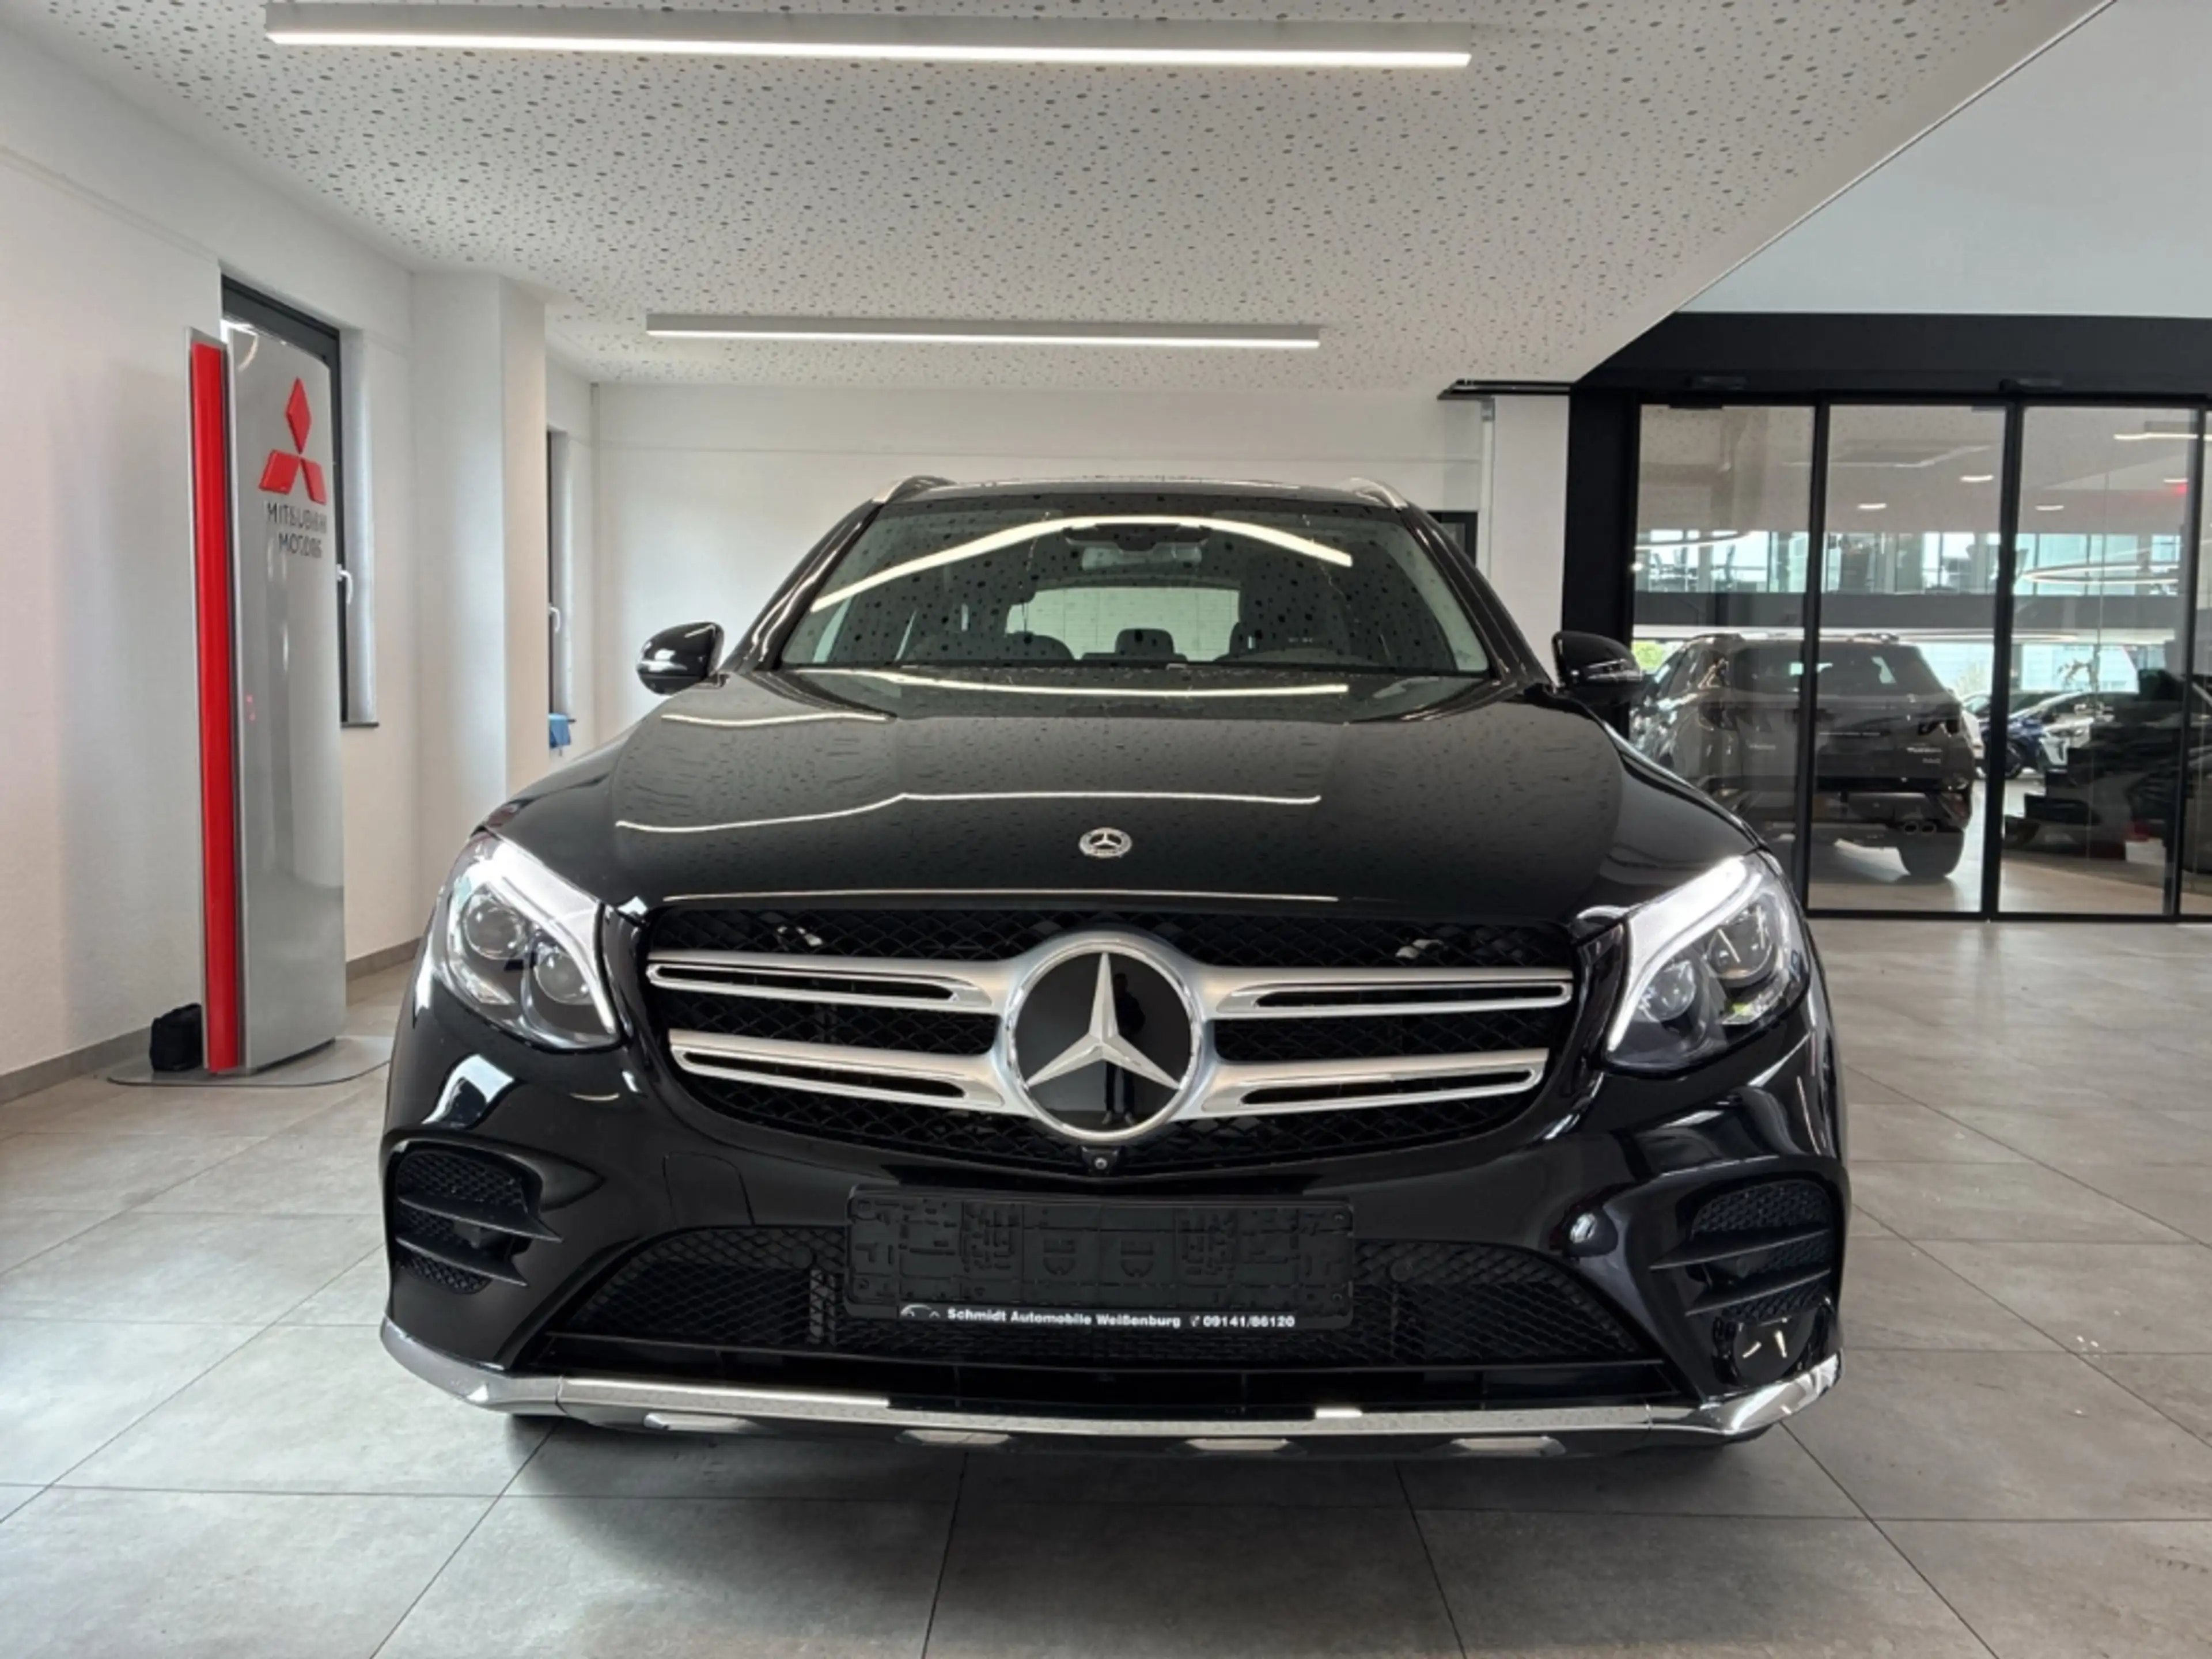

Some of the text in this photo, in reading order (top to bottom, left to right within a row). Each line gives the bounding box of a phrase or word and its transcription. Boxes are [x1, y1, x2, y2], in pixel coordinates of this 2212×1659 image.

[946, 1306, 1007, 1322] Schmidt
[1010, 1310, 1092, 1325] Automobile
[1095, 1313, 1181, 1328] Weißenburg
